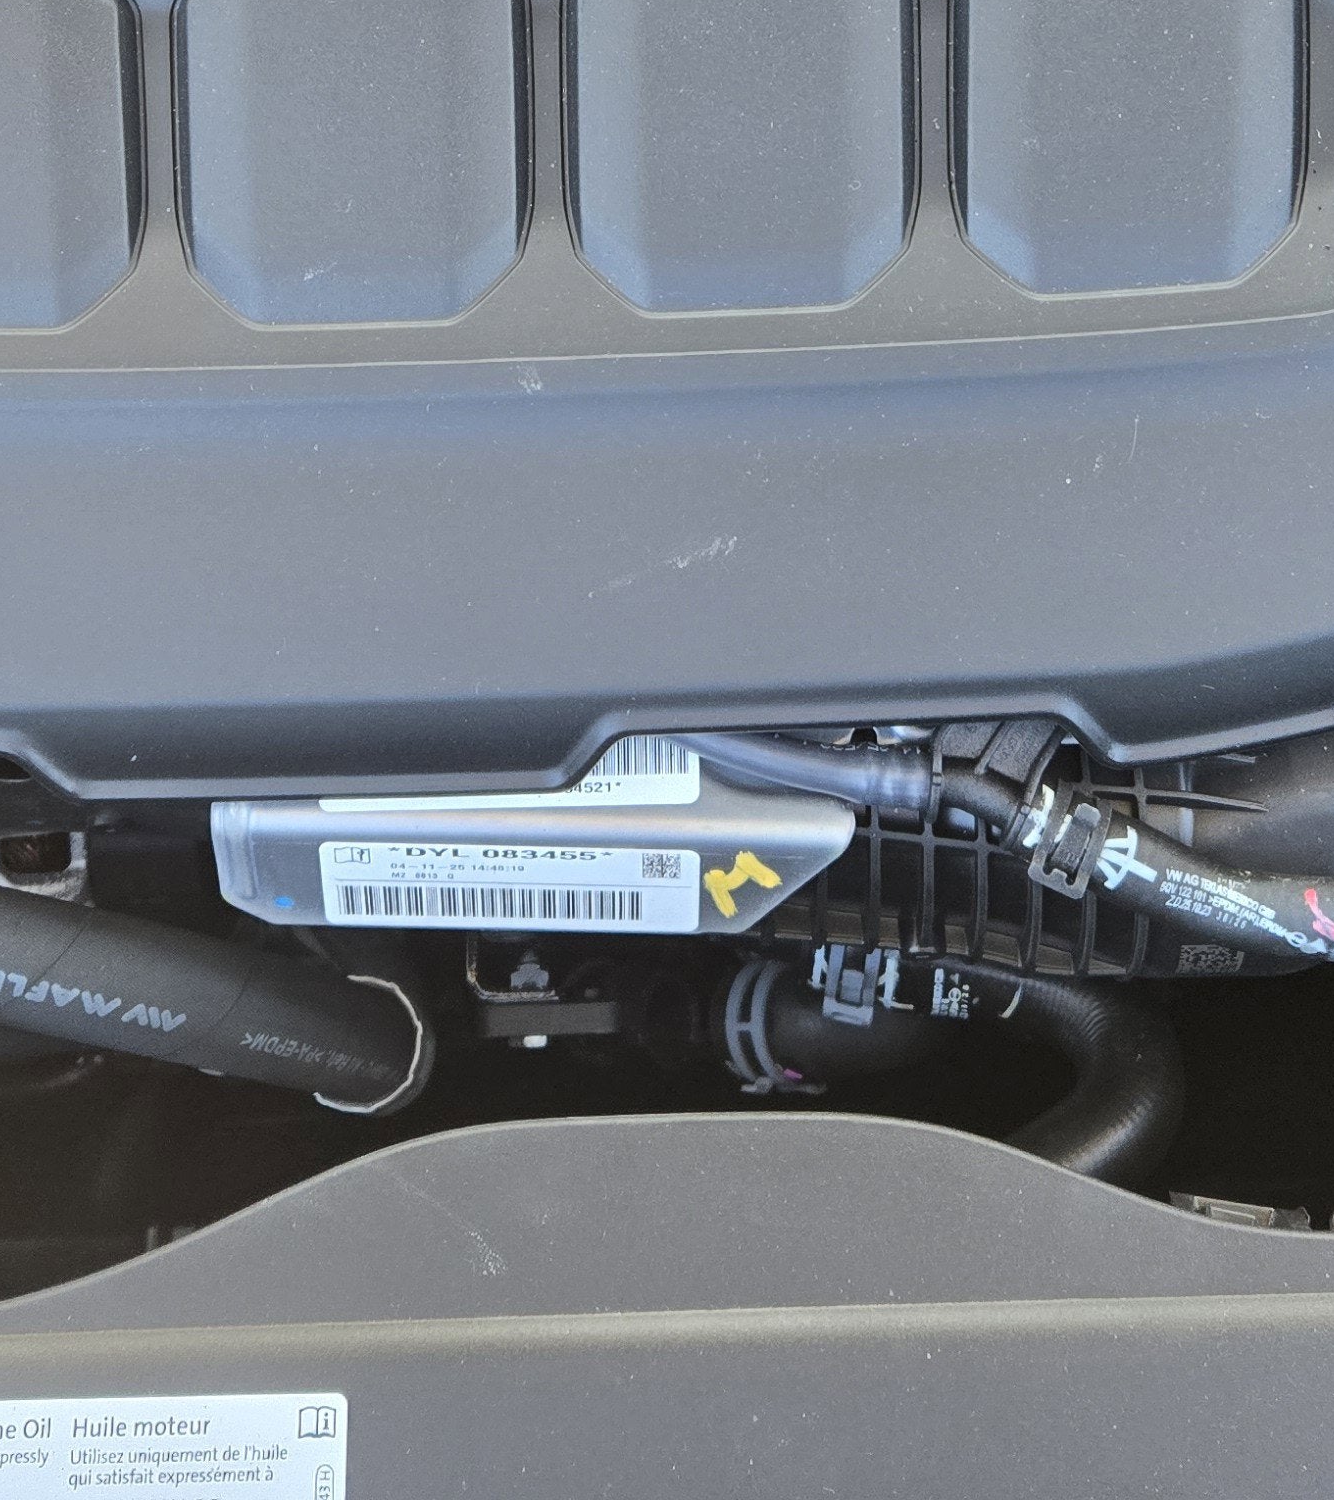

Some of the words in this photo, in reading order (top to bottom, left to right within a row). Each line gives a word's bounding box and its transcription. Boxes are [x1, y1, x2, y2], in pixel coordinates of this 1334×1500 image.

[22, 1417, 52, 1441] Oil
[72, 1417, 129, 1439] Huile
[133, 1417, 211, 1438] moteur
[70, 1447, 125, 1465] Utilisez
[128, 1446, 218, 1465] uniquement
[221, 1445, 240, 1462] de
[243, 1444, 288, 1462] l'huile
[68, 1469, 92, 1489] qui
[94, 1467, 154, 1484] satisfait
[157, 1466, 262, 1487] expressément
[264, 1465, 274, 1482] à
